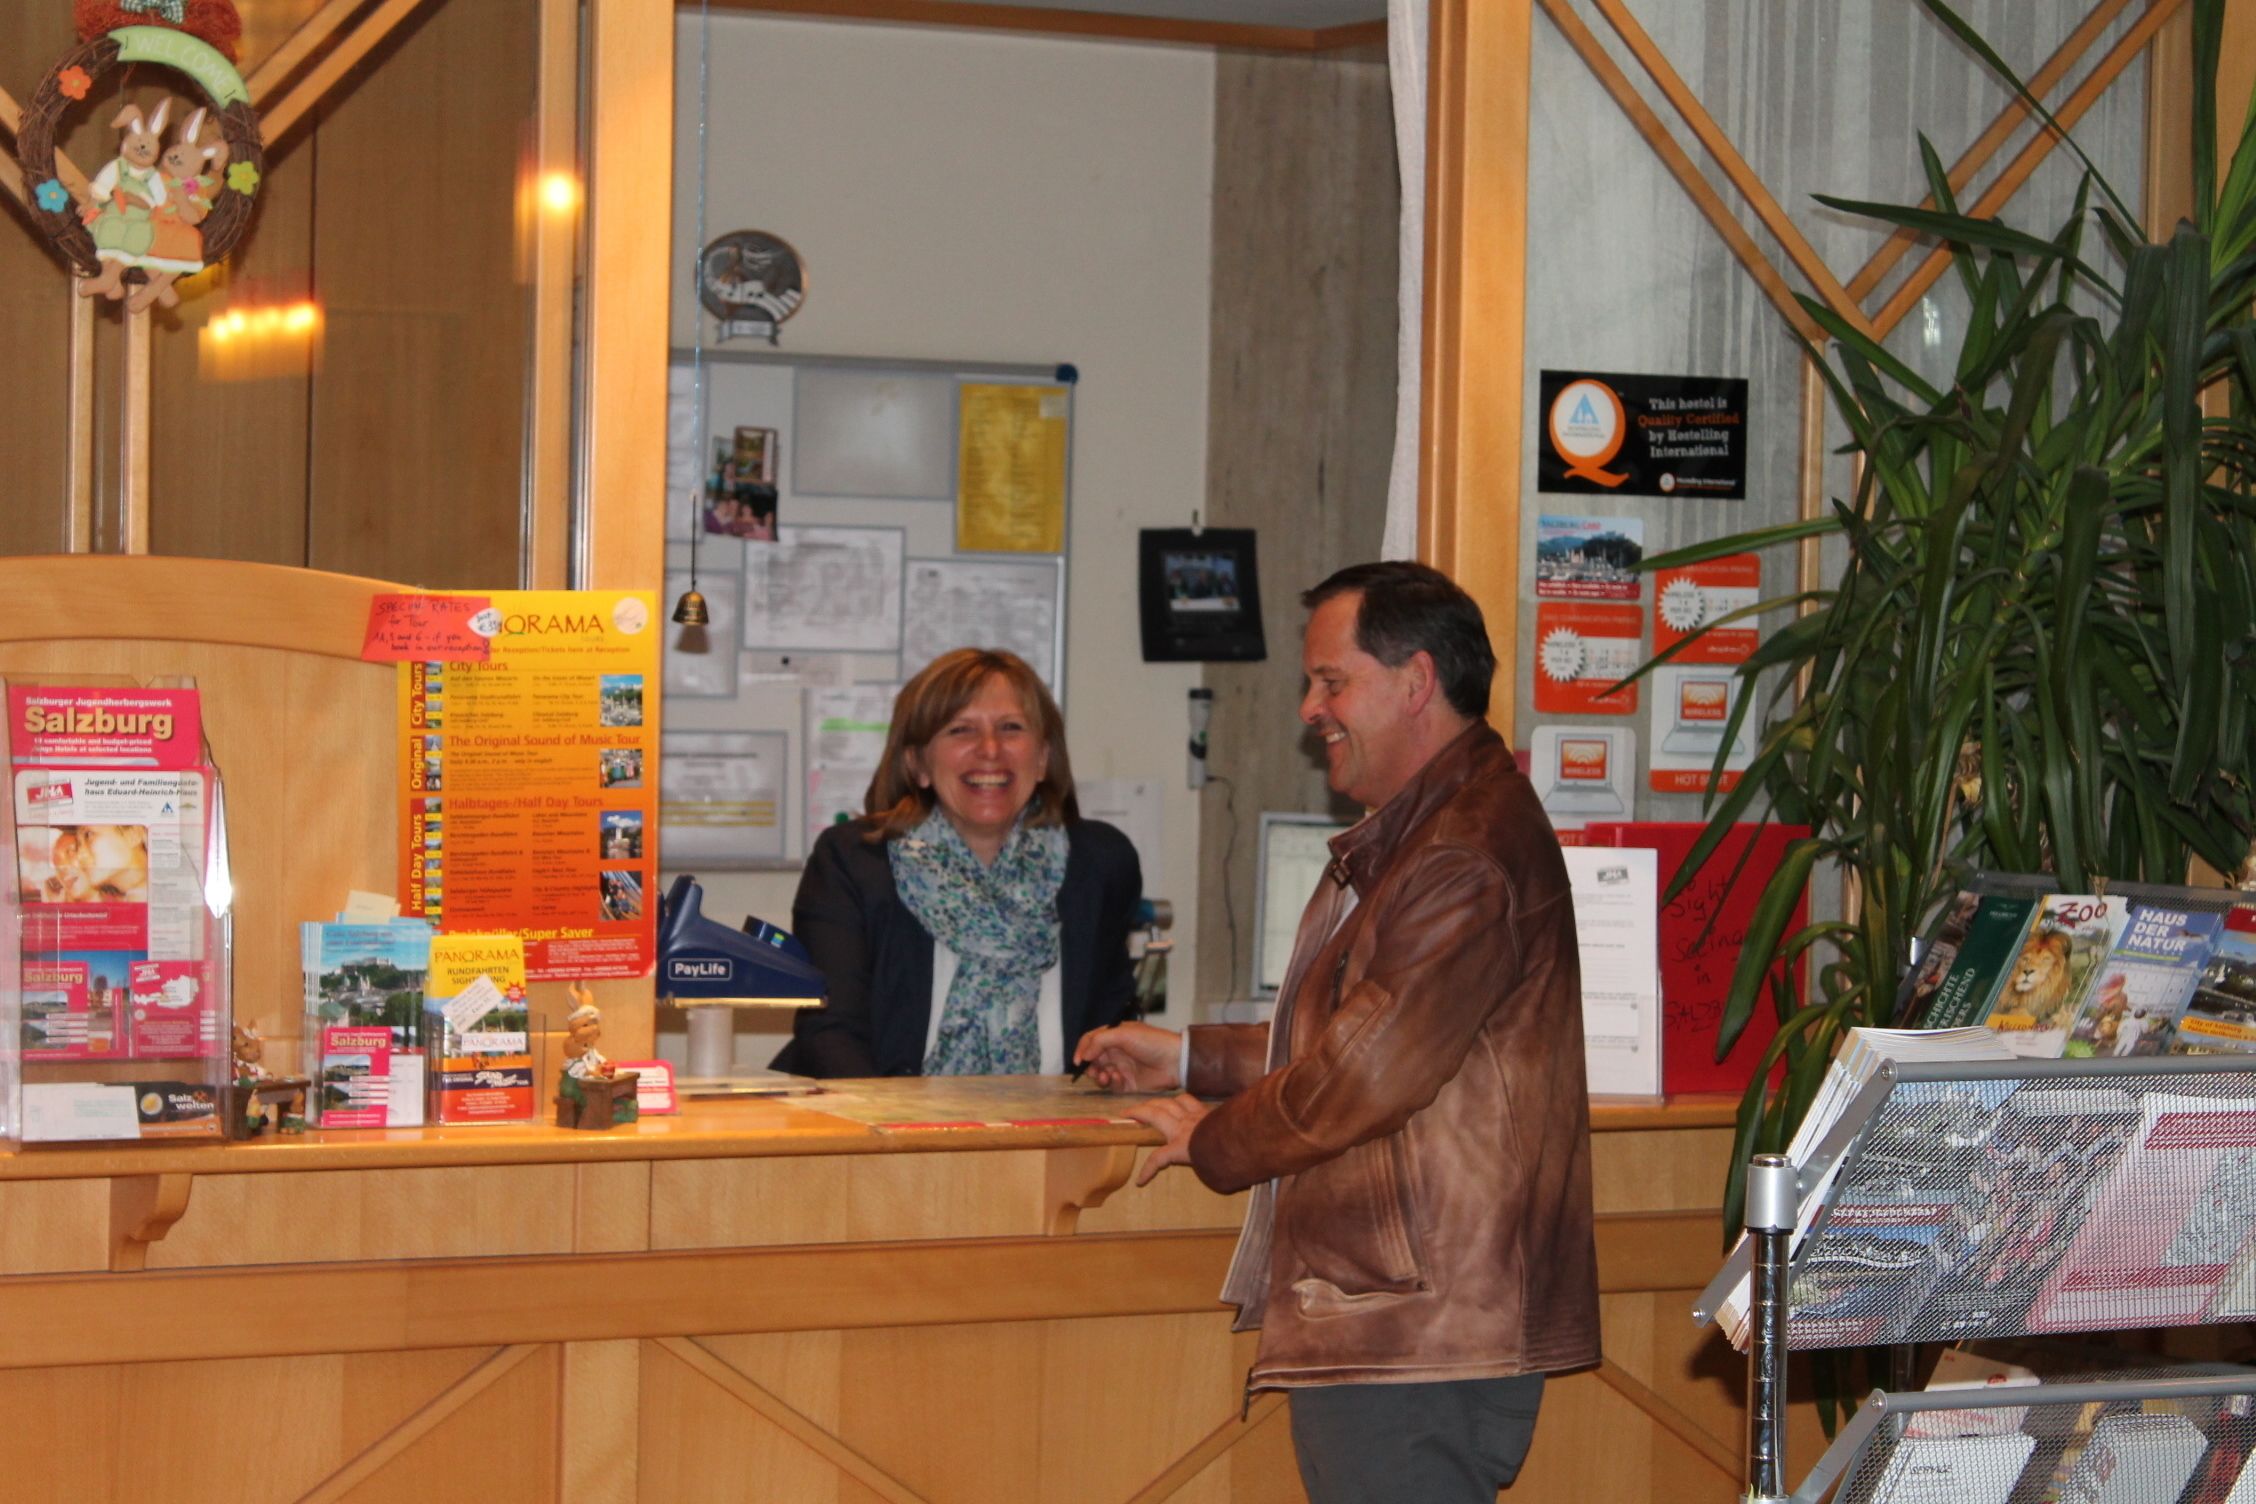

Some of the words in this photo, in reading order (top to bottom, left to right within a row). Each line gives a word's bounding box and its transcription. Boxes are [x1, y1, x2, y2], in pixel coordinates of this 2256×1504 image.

[136, 35, 230, 92] WELCOME
[1649, 398, 1676, 410] This
[1679, 397, 1714, 409] hostel
[1717, 397, 1727, 409] is
[1638, 414, 1682, 428] Quality
[1685, 413, 1740, 425] Certified
[1649, 430, 1664, 445] by
[1668, 428, 1729, 442] Hostelling
[1650, 445, 1729, 458] International
[500, 614, 604, 635] ORAMA
[449, 661, 472, 673] City
[477, 661, 508, 672] Tours
[411, 664, 423, 694] Tours
[411, 702, 424, 726] City
[24, 706, 174, 741] Salzburg
[450, 736, 471, 746] The
[474, 735, 520, 748] Original
[524, 735, 559, 746] Sound
[564, 734, 576, 745] of
[580, 734, 611, 745] Music
[617, 733, 640, 744] Tour
[411, 738, 424, 790] Original
[85, 778, 118, 787] Jugend-
[1675, 774, 1697, 785] HOT
[85, 788, 104, 796] haus
[545, 797, 568, 809] Day
[573, 796, 604, 808] Tours
[411, 814, 422, 849] Tours
[411, 854, 424, 878] Day
[411, 885, 422, 911] Half
[2139, 909, 2188, 927] HAUS
[561, 927, 594, 938] Saver
[2133, 922, 2170, 937] DER
[2127, 934, 2187, 951] NATUR
[435, 949, 520, 963] PANORAMA
[447, 966, 509, 975] RUNDFAHRTEN
[675, 962, 726, 977] PayLife
[24, 972, 83, 984] Salzburg
[2190, 1019, 2203, 1027] City
[330, 1034, 387, 1048] Salzburg
[168, 1093, 193, 1103] Salz
[175, 1100, 214, 1110] welten
